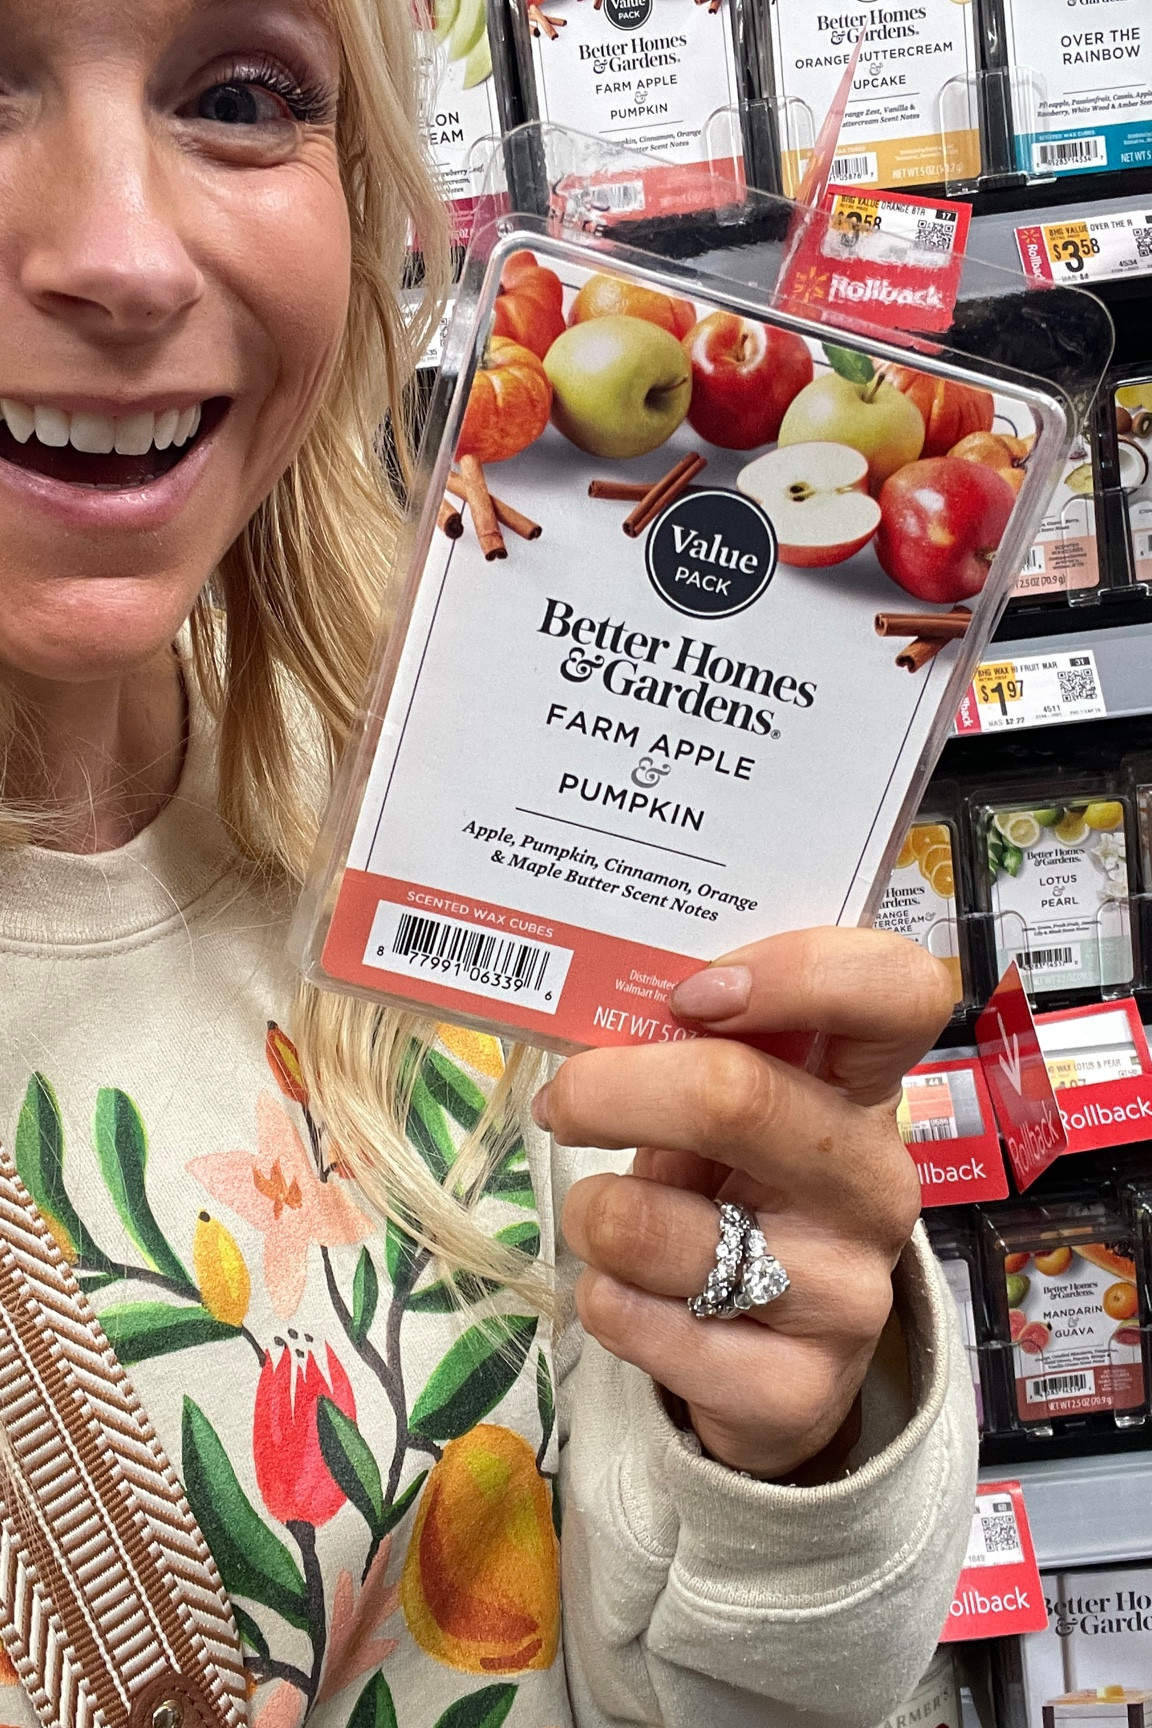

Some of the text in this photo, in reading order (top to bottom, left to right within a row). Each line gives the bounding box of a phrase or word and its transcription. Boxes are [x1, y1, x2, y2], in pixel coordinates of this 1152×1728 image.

[618, 11, 640, 20] PACK
[817, 7, 926, 31] Better Homes
[579, 34, 687, 60] Better Homes
[1061, 28, 1141, 47] OVER THE
[795, 54, 850, 69] ORANGE
[1063, 45, 1141, 65] RAINBOW
[595, 74, 678, 95] FARM APPLE
[853, 75, 907, 90] UPCAKE
[610, 103, 668, 120] PUMPKIN
[845, 109, 864, 118] range
[1071, 106, 1090, 114] White
[1091, 103, 1110, 112] Wood
[1117, 100, 1138, 109] Amber
[880, 115, 899, 124] Scent
[900, 113, 920, 121] Notes
[676, 129, 702, 138] Orange
[881, 201, 909, 213] ORANGE
[1090, 222, 1109, 231] OVER
[1111, 220, 1125, 229] THE
[828, 272, 945, 308] Rollback
[671, 524, 759, 574] Value
[674, 566, 732, 596] PACK
[536, 597, 818, 708] Better Homes
[994, 667, 1009, 676] WAX
[1020, 663, 1040, 672] FRUIT
[1042, 661, 1058, 670] MAR
[546, 703, 756, 781] FARM APPLE
[630, 756, 672, 789] &
[558, 773, 705, 831] PUMPKIN
[1027, 847, 1085, 860] Better Homes
[462, 819, 759, 912] Apple, Pumpkin, Cinnamon, Orange
[490, 850, 719, 922] & Maple Butter Scent Notes
[1039, 874, 1077, 887] LOTUS
[886, 886, 925, 898] Homes
[1041, 897, 1079, 908] PEARL
[406, 890, 554, 938] SCENTED WAX CUBES
[873, 915, 925, 929] TERCREAM
[876, 910, 909, 920] RANGE
[376, 945, 553, 1001] 8 77991 06339 6
[615, 978, 653, 999] Walmart
[593, 1005, 629, 1032] NET
[630, 1015, 660, 1040] WT
[658, 1024, 672, 1043] 5
[1074, 1062, 1095, 1071] LOTUS
[1008, 1099, 1060, 1176] Rollback
[917, 1157, 987, 1184] llback
[1043, 1305, 1103, 1320] MANDARIN
[1055, 1326, 1094, 1338] GUAVA
[949, 1586, 1030, 1617] ollback
